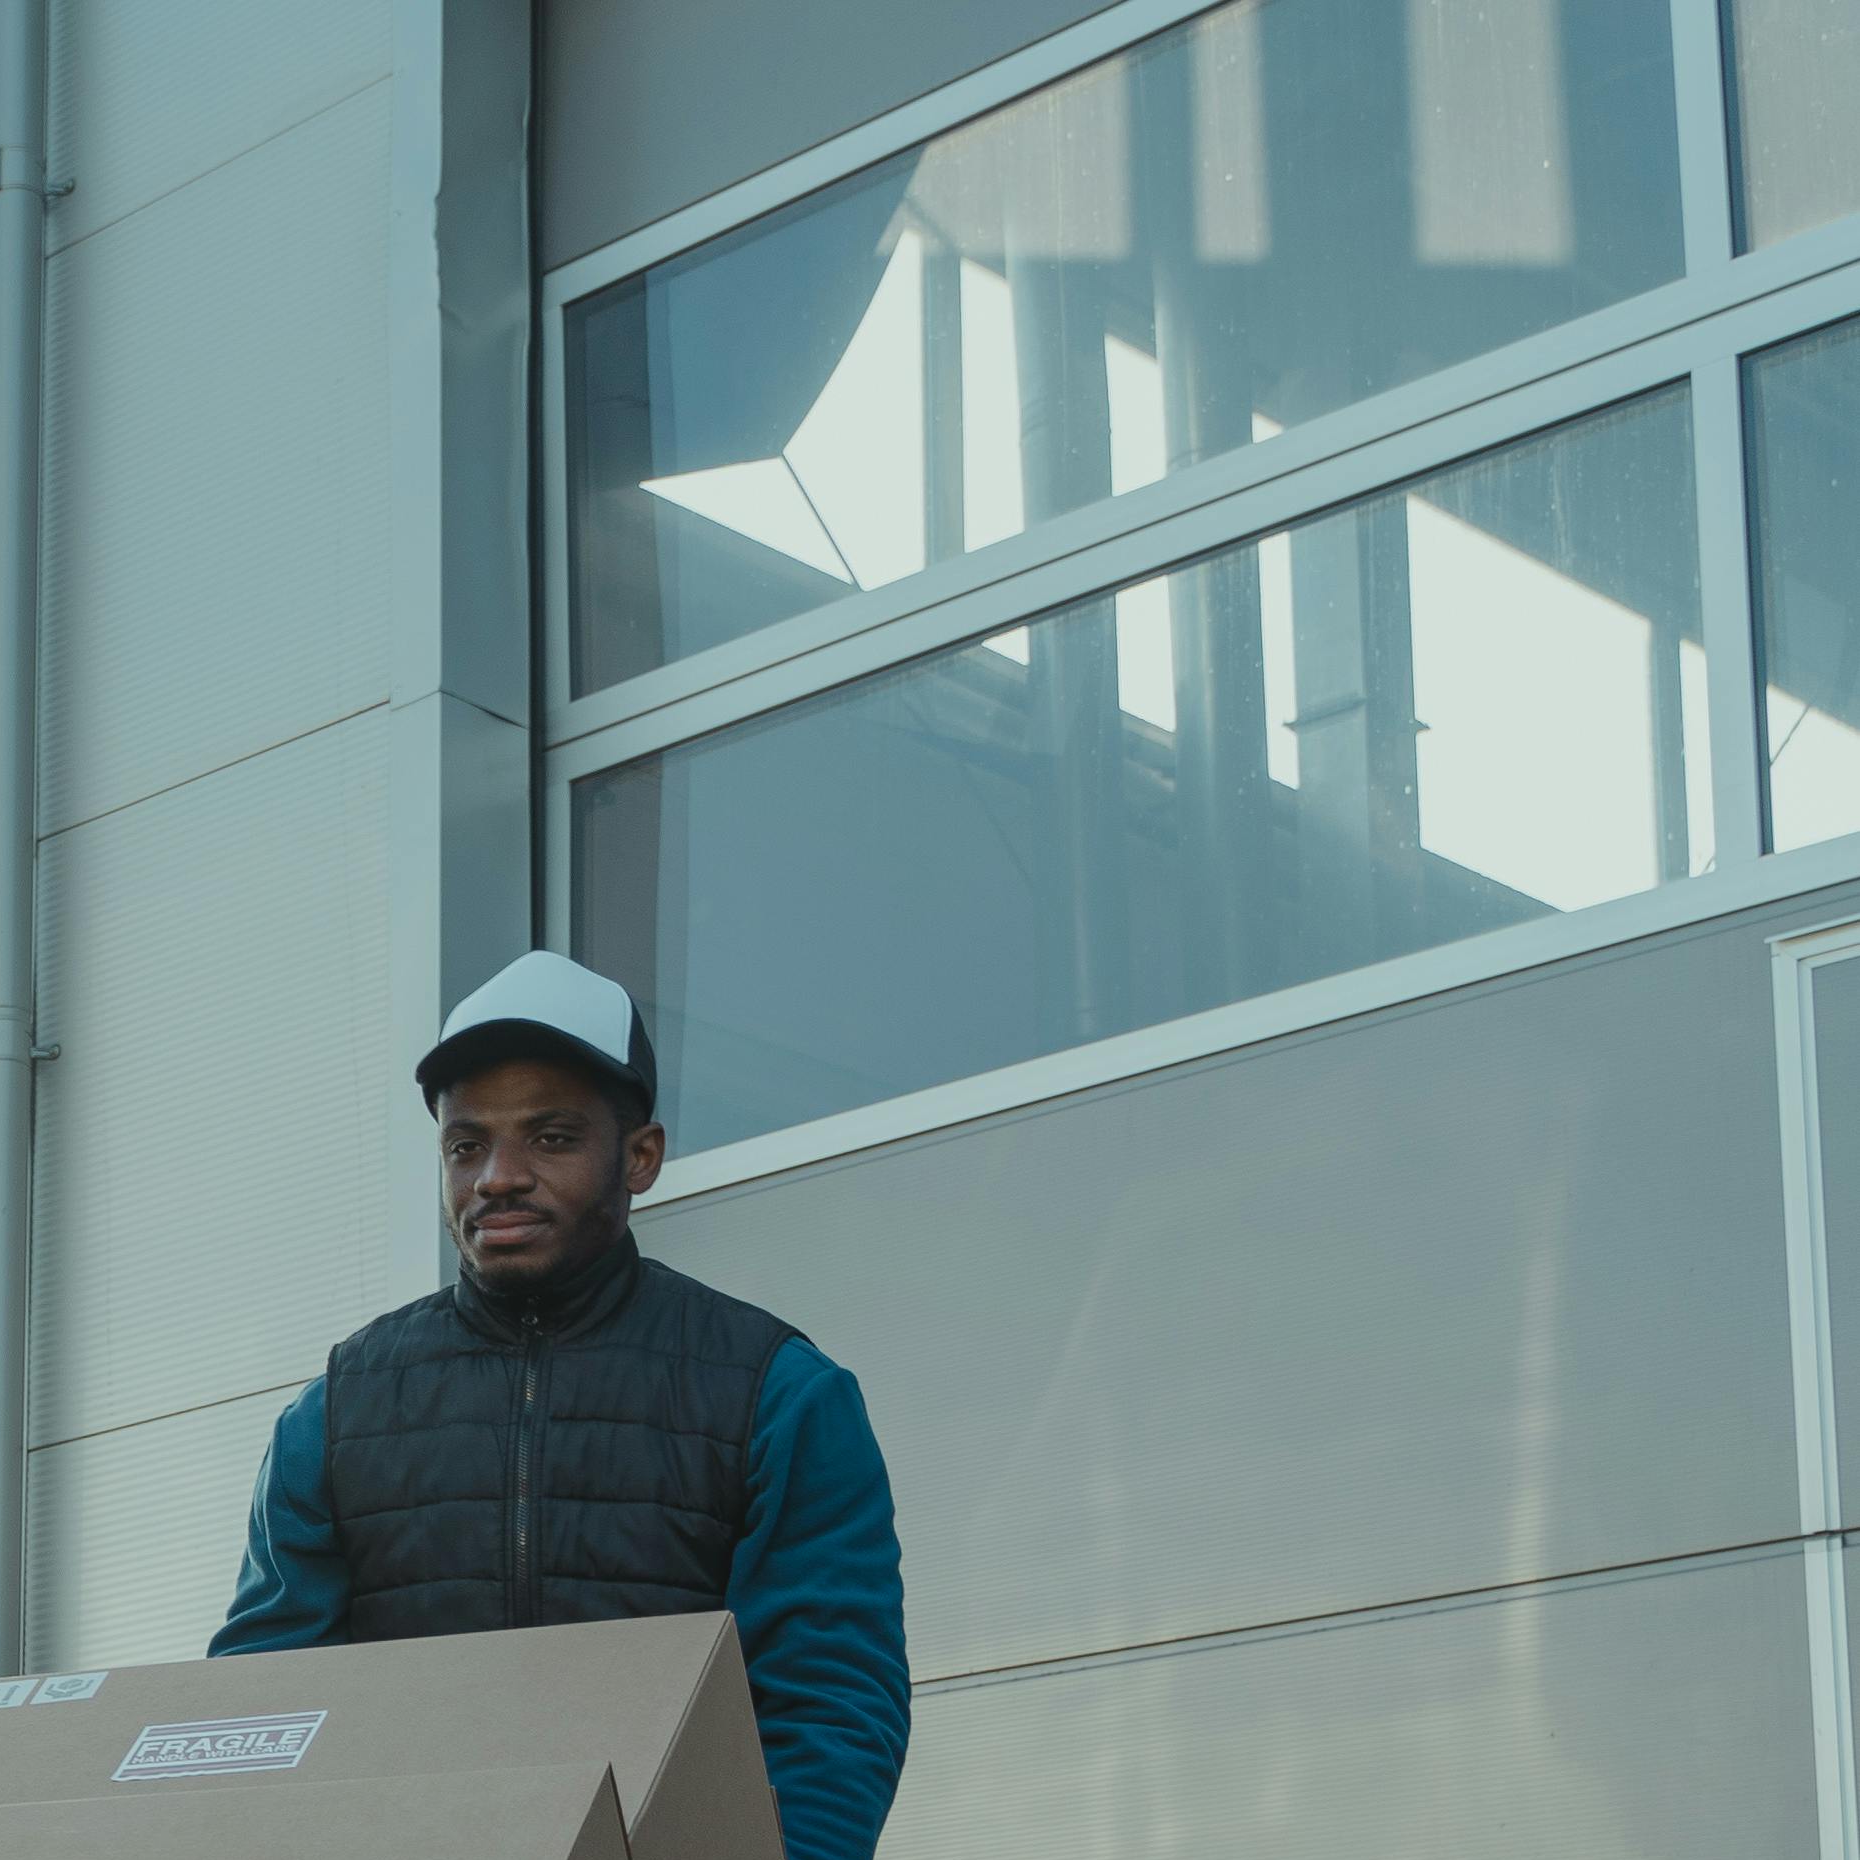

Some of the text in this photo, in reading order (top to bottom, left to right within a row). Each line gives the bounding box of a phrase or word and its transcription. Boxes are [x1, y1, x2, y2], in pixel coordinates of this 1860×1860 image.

[131, 1743, 300, 1765] HANDLE WITH CARE
[134, 1728, 307, 1757] FRAGILE
